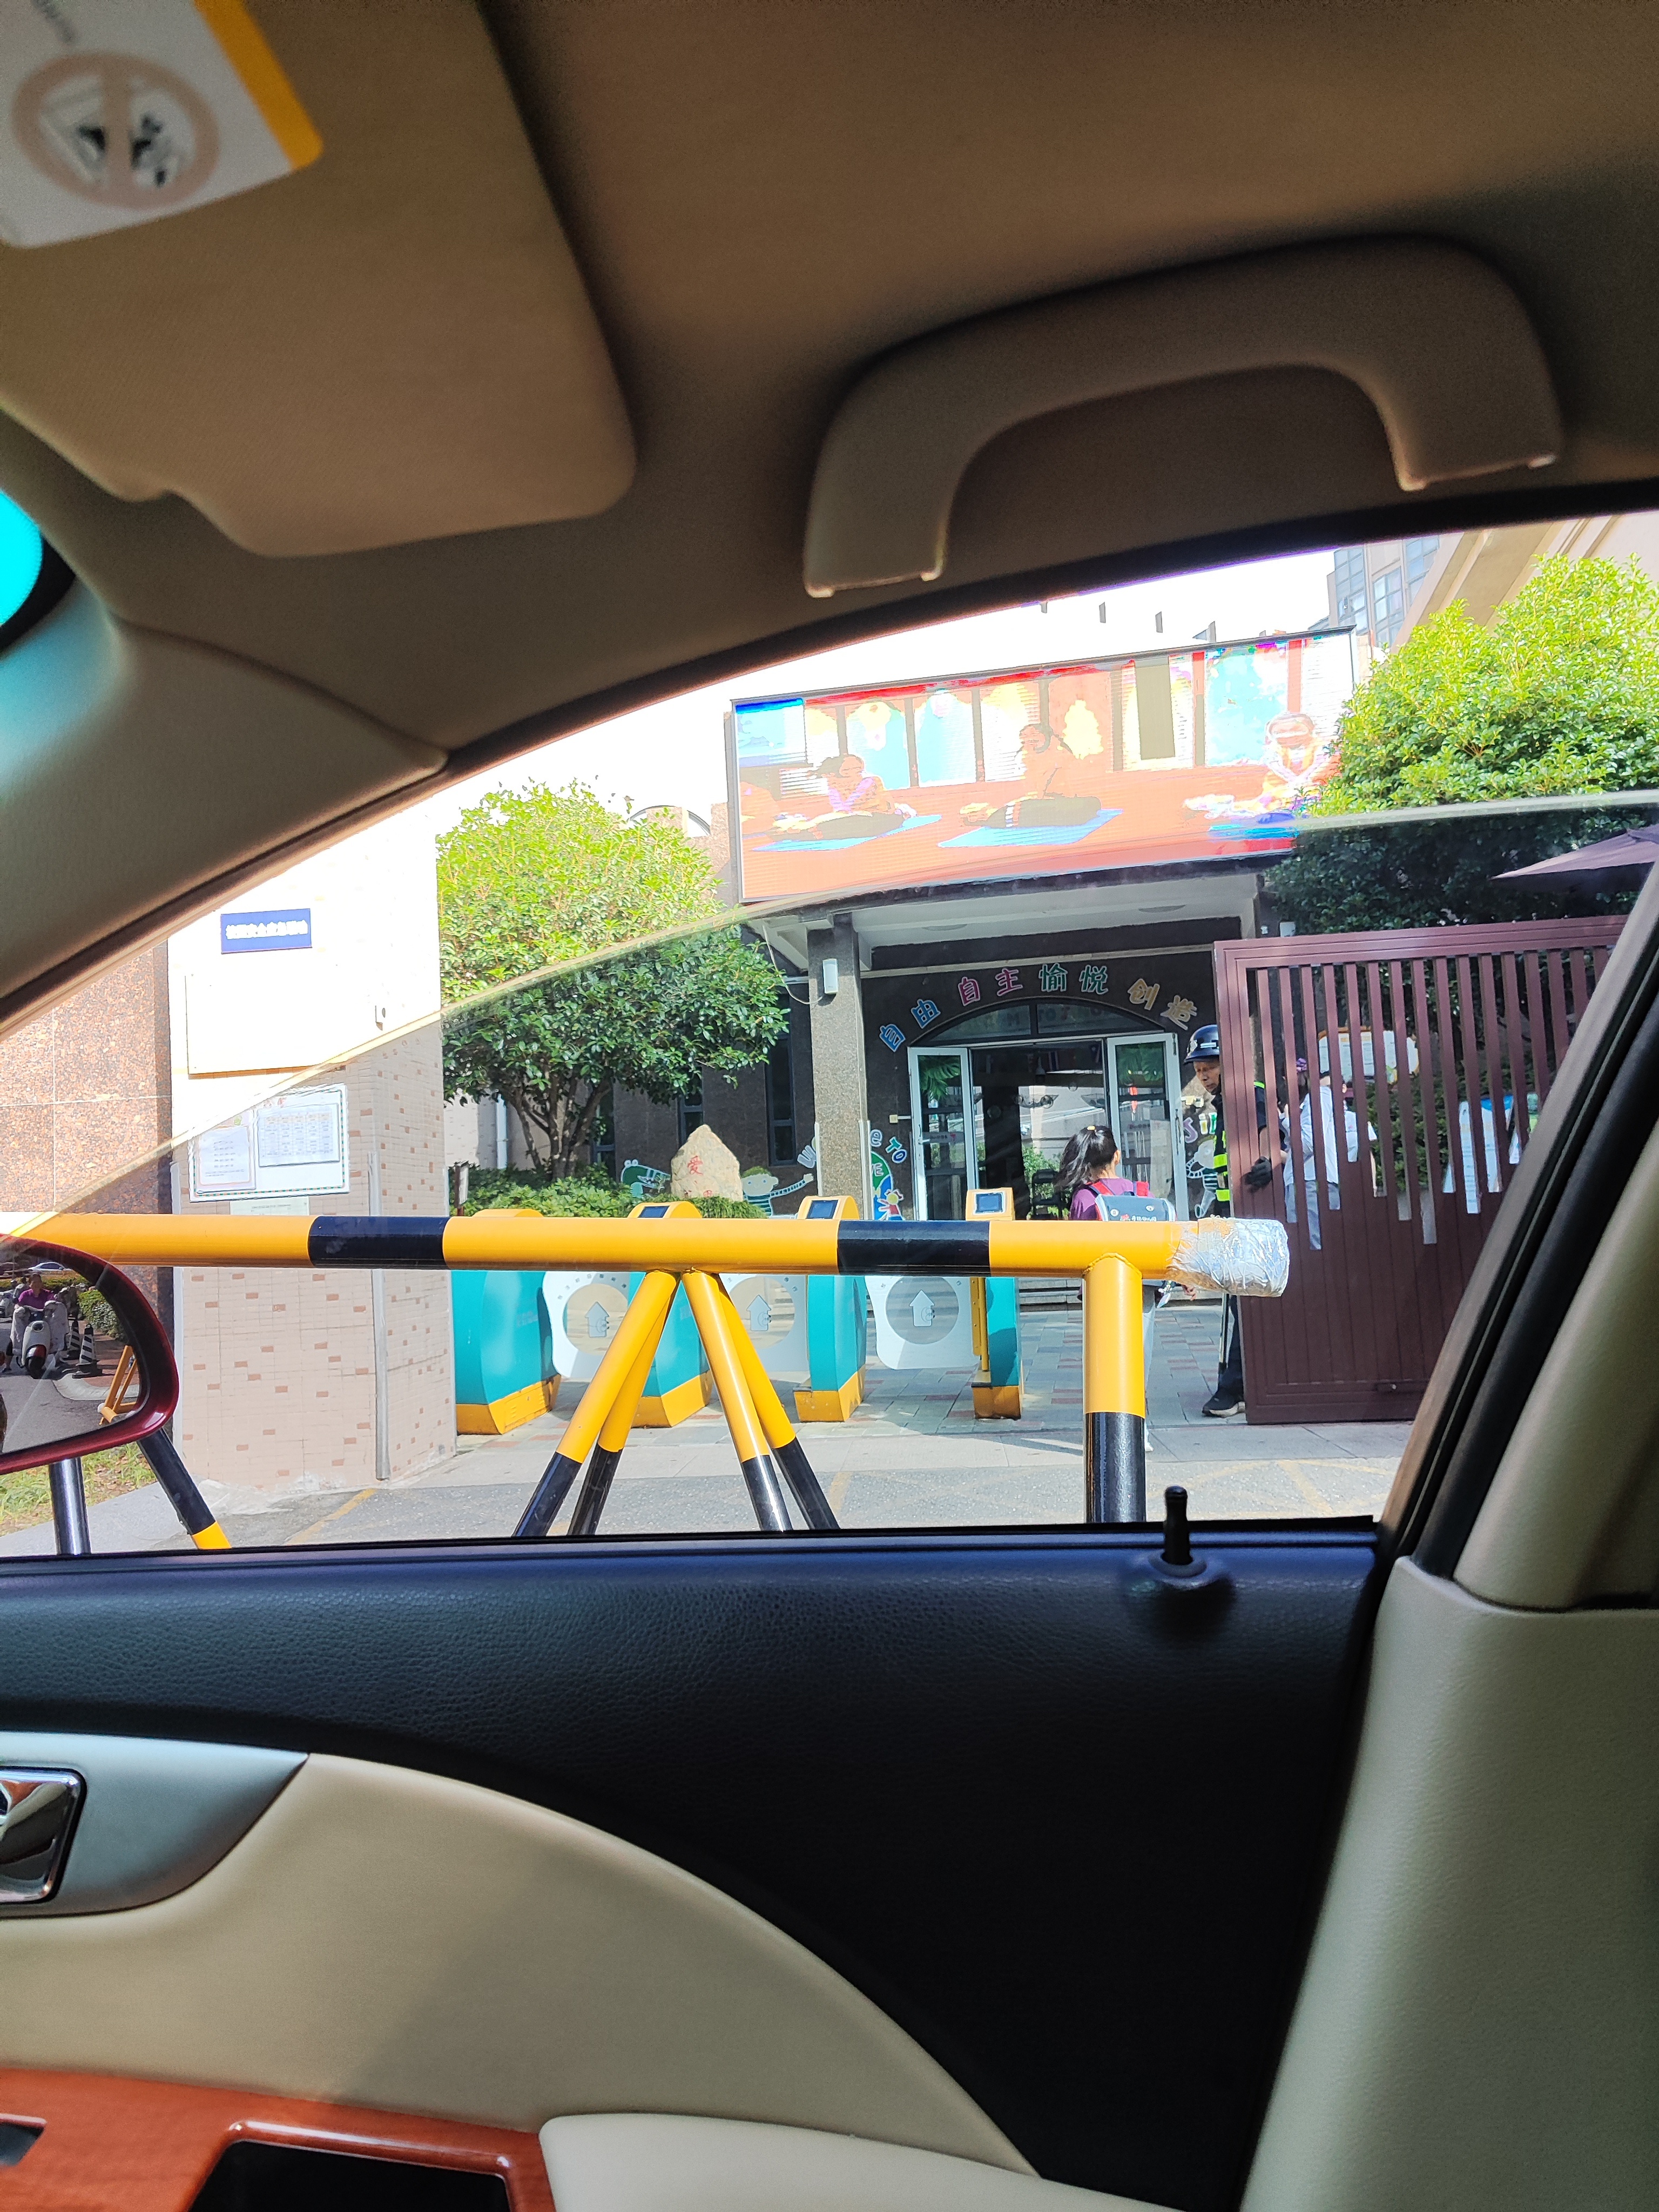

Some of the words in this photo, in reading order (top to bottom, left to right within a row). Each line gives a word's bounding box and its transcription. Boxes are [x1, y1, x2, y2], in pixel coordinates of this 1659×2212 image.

[879, 999, 941, 1053] 自由
[958, 968, 1023, 1006] 自主
[1038, 963, 1108, 995] 愉悦
[1128, 979, 1197, 1030] 创造
